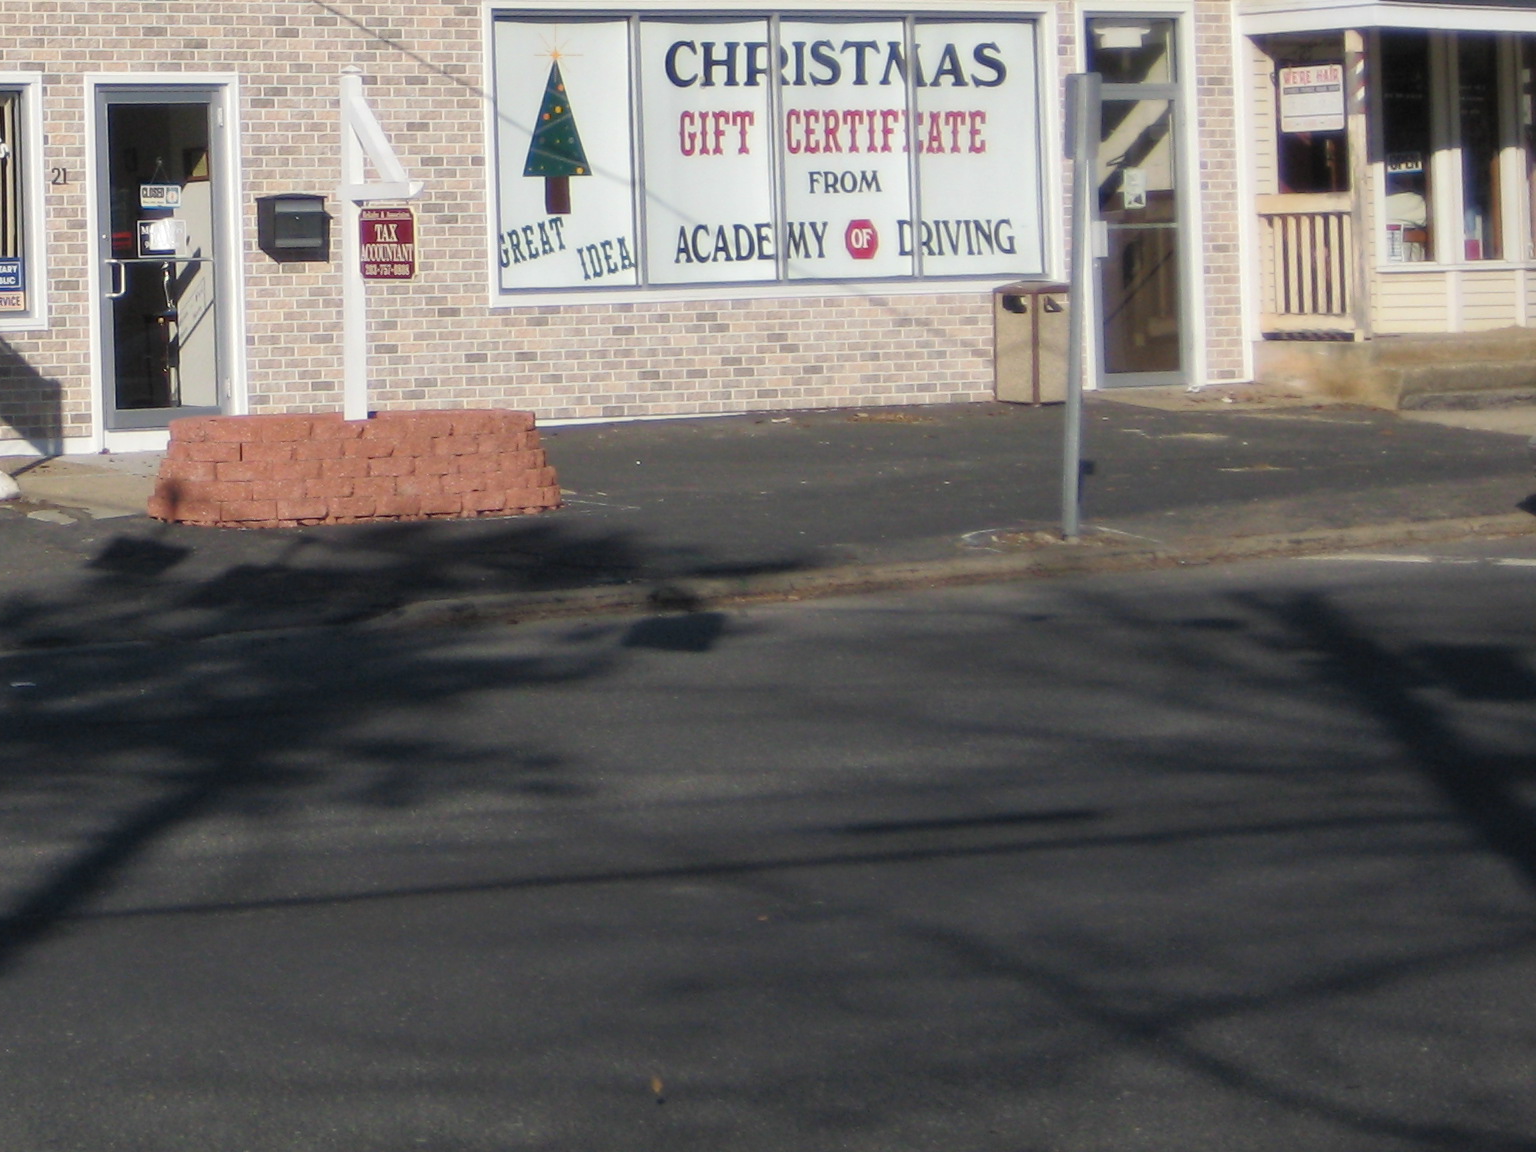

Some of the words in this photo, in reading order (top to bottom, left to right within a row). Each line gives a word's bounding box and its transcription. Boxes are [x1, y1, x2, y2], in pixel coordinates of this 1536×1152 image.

[665, 39, 1007, 88] CHRISTMAS
[680, 110, 755, 156] GIFT
[51, 167, 67, 185] 21
[808, 170, 882, 194] FROM
[374, 223, 398, 242] TAX
[499, 216, 566, 268] GREAT
[576, 236, 636, 281] IDEA
[674, 221, 828, 263] ACADEMY
[850, 228, 873, 249] OF
[896, 218, 1017, 256] DRIVING
[360, 243, 414, 261] ACCOUNTANT
